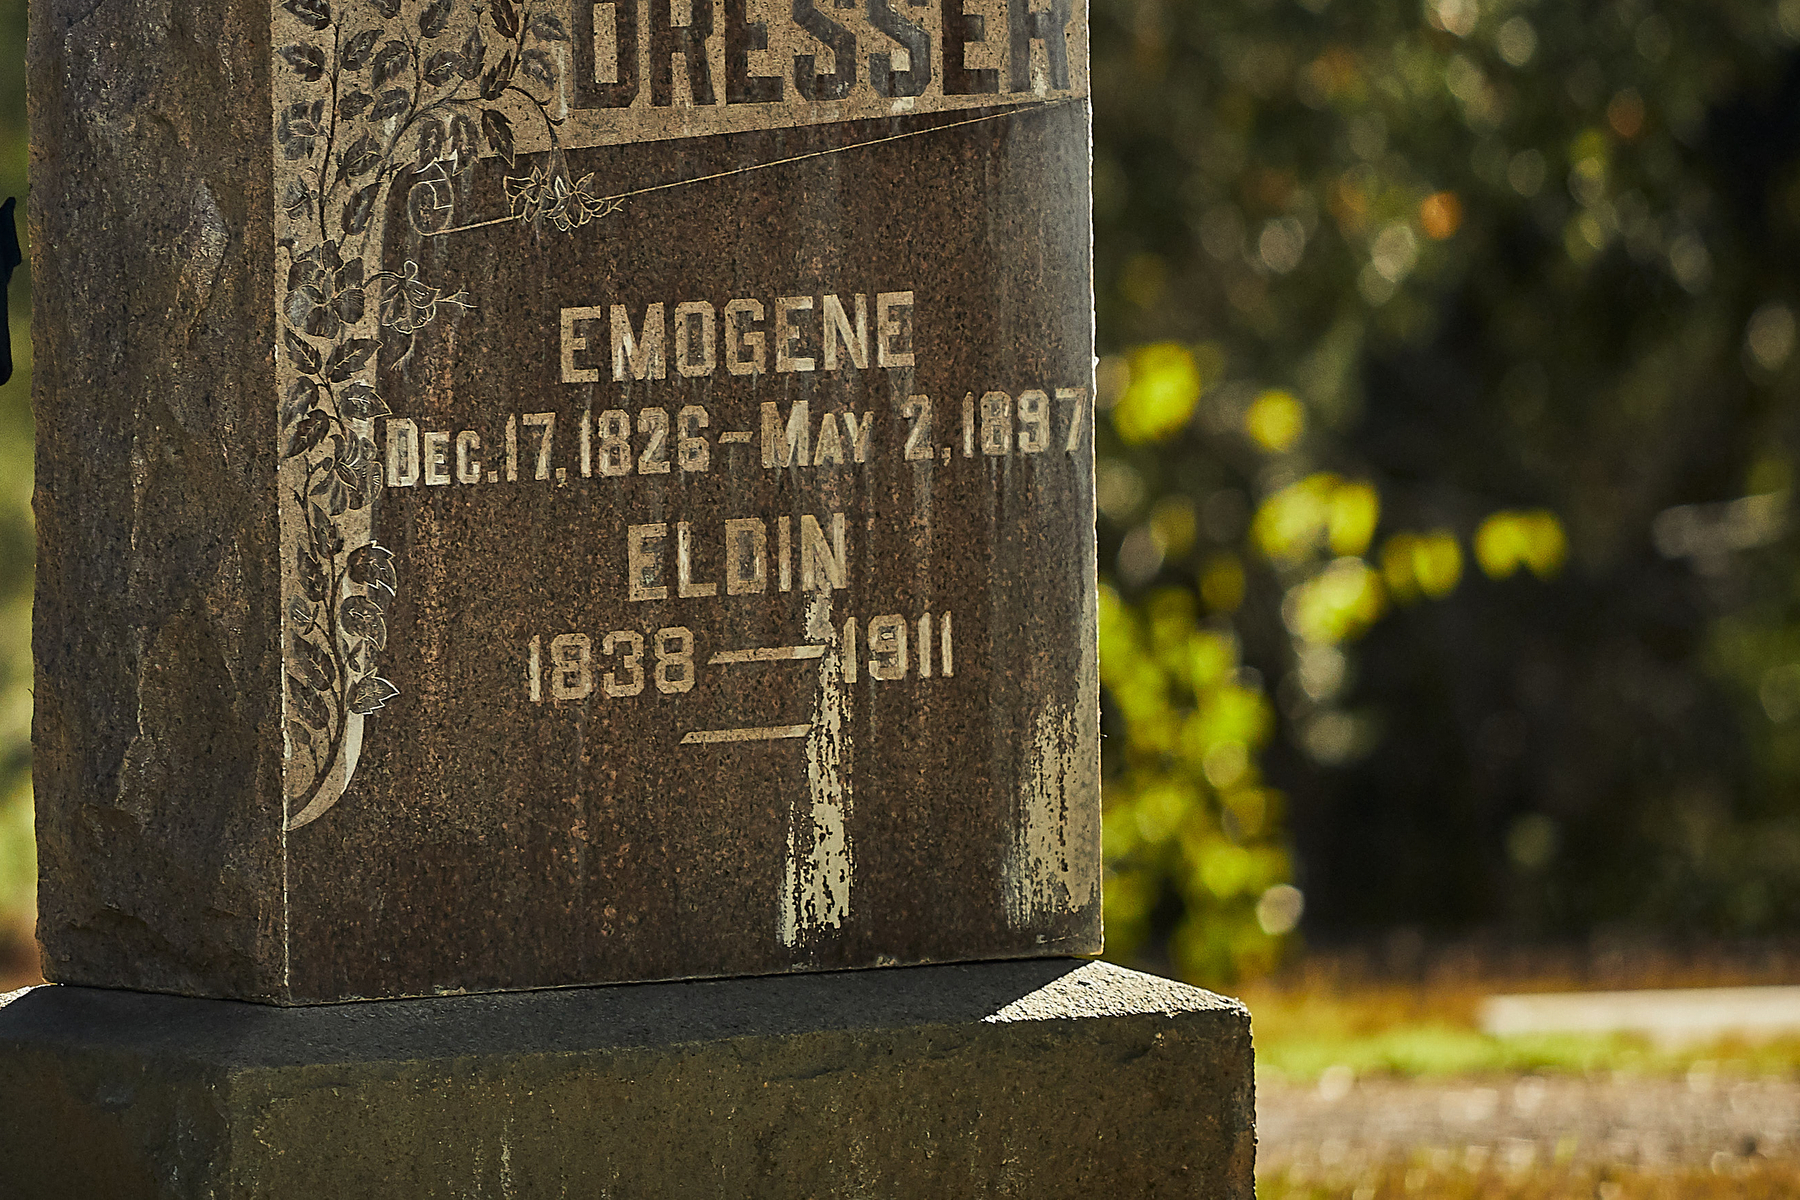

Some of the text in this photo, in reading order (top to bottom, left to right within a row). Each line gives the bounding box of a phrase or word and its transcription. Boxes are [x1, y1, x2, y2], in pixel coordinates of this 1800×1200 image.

[560, 290, 916, 384] EMOGENE
[627, 512, 848, 602] ELDIN
[528, 626, 696, 702] 1838
[842, 610, 954, 684] 1911
